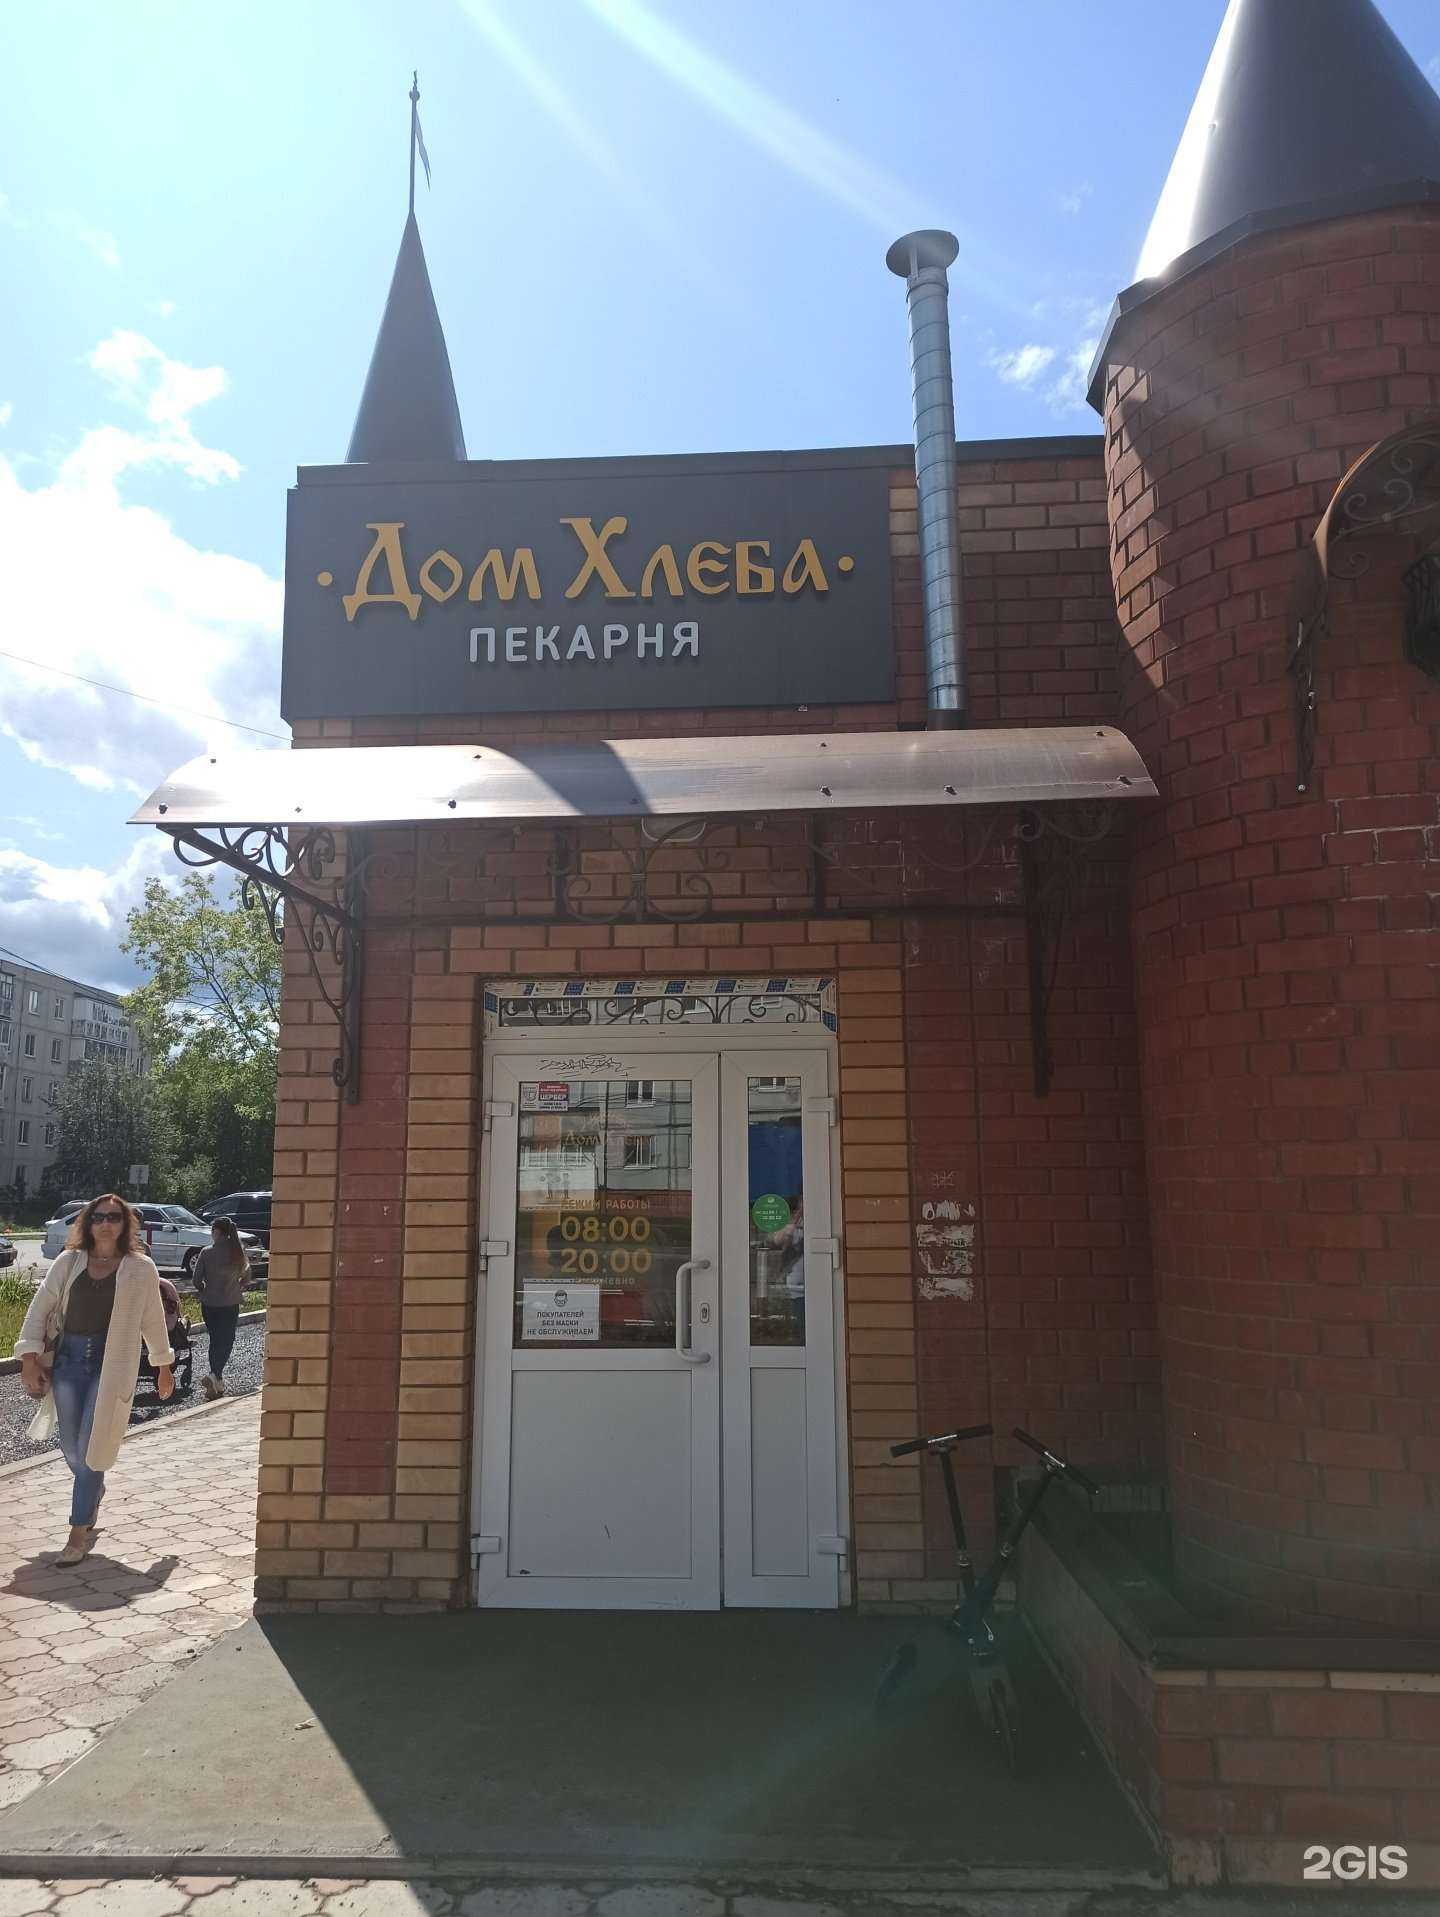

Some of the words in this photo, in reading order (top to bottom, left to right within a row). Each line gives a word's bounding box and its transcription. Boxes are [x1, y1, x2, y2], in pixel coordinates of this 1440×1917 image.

[469, 621, 699, 662] ПЕКАРНЯ
[606, 1199, 650, 1209] РАБОТЫ
[561, 1216, 651, 1242] 08:00
[561, 1248, 651, 1273] 20:00
[537, 1310, 584, 1318] ПОКУПАТЕЛЕЙ
[527, 1328, 537, 1336] НЕ
